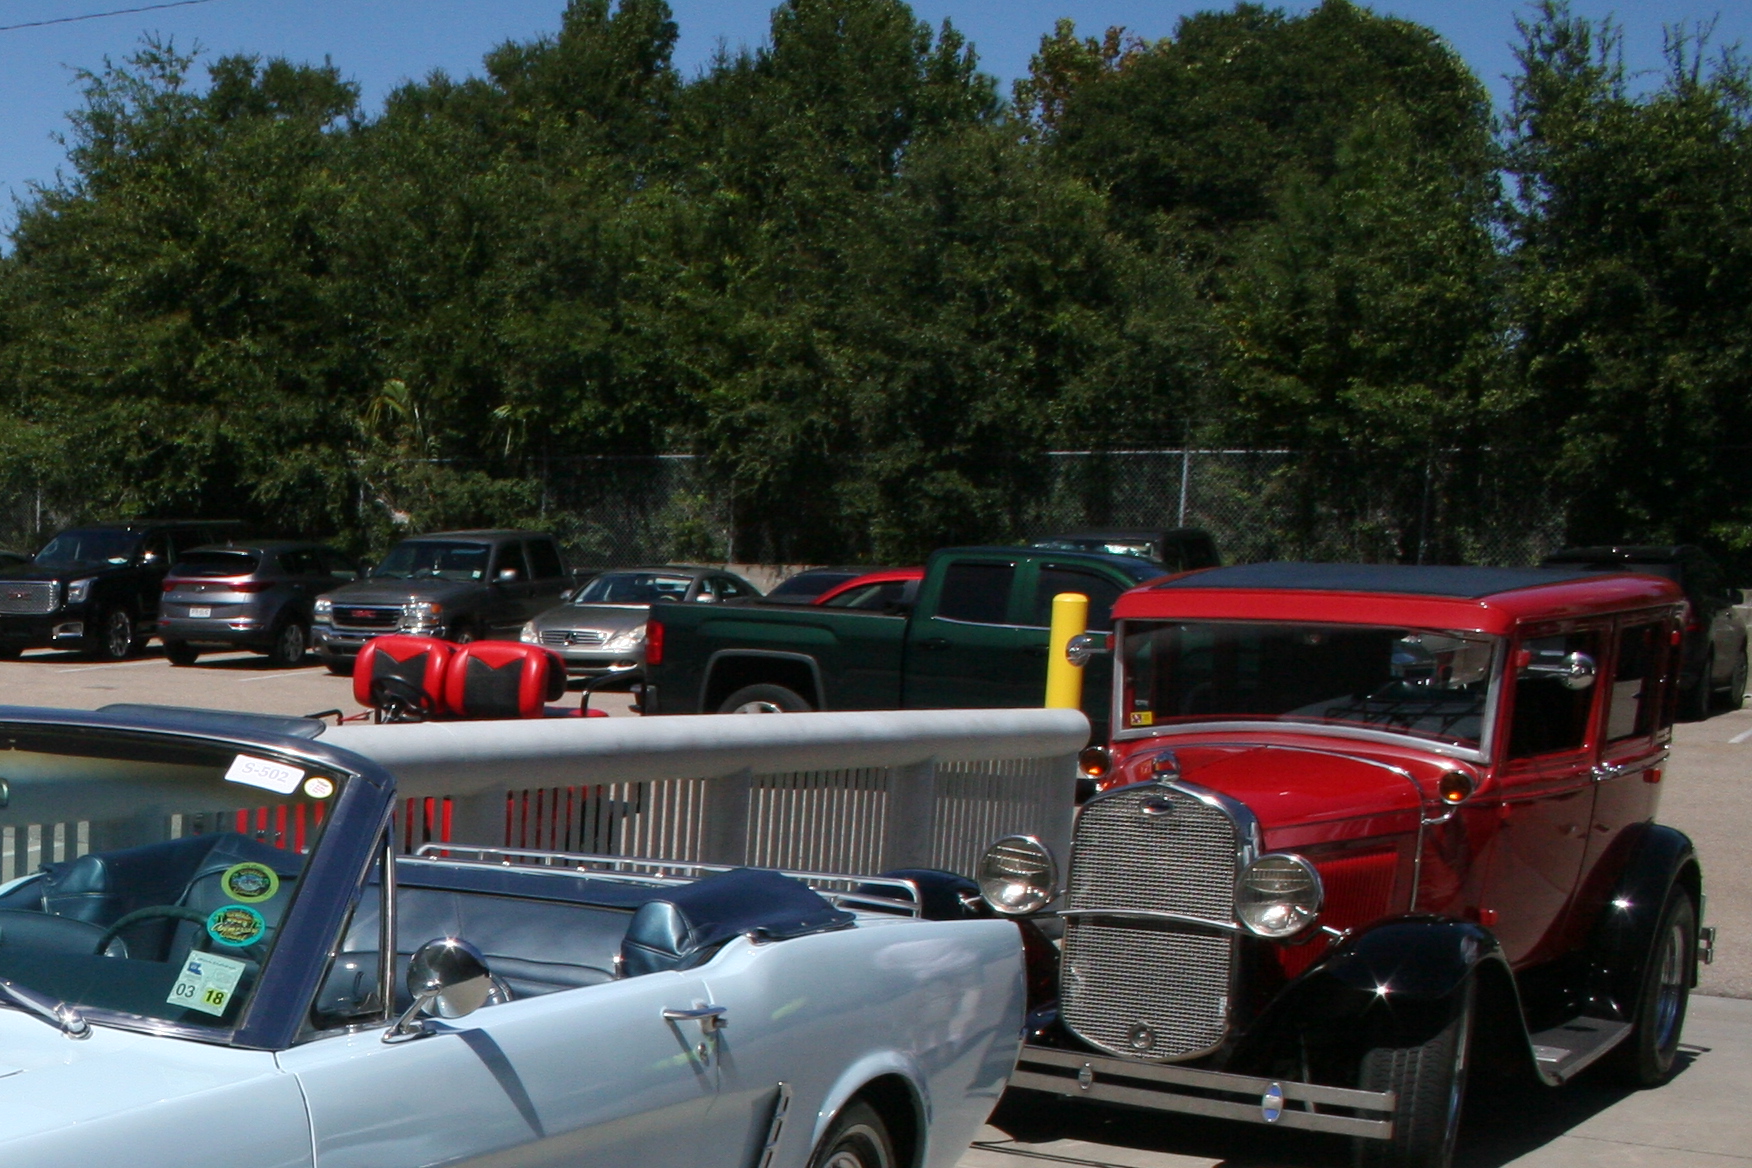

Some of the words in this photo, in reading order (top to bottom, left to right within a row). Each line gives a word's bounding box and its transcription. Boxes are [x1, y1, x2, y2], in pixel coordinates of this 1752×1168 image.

[241, 762, 289, 783] S-502
[176, 983, 195, 998] 03
[205, 989, 224, 1005] 18
